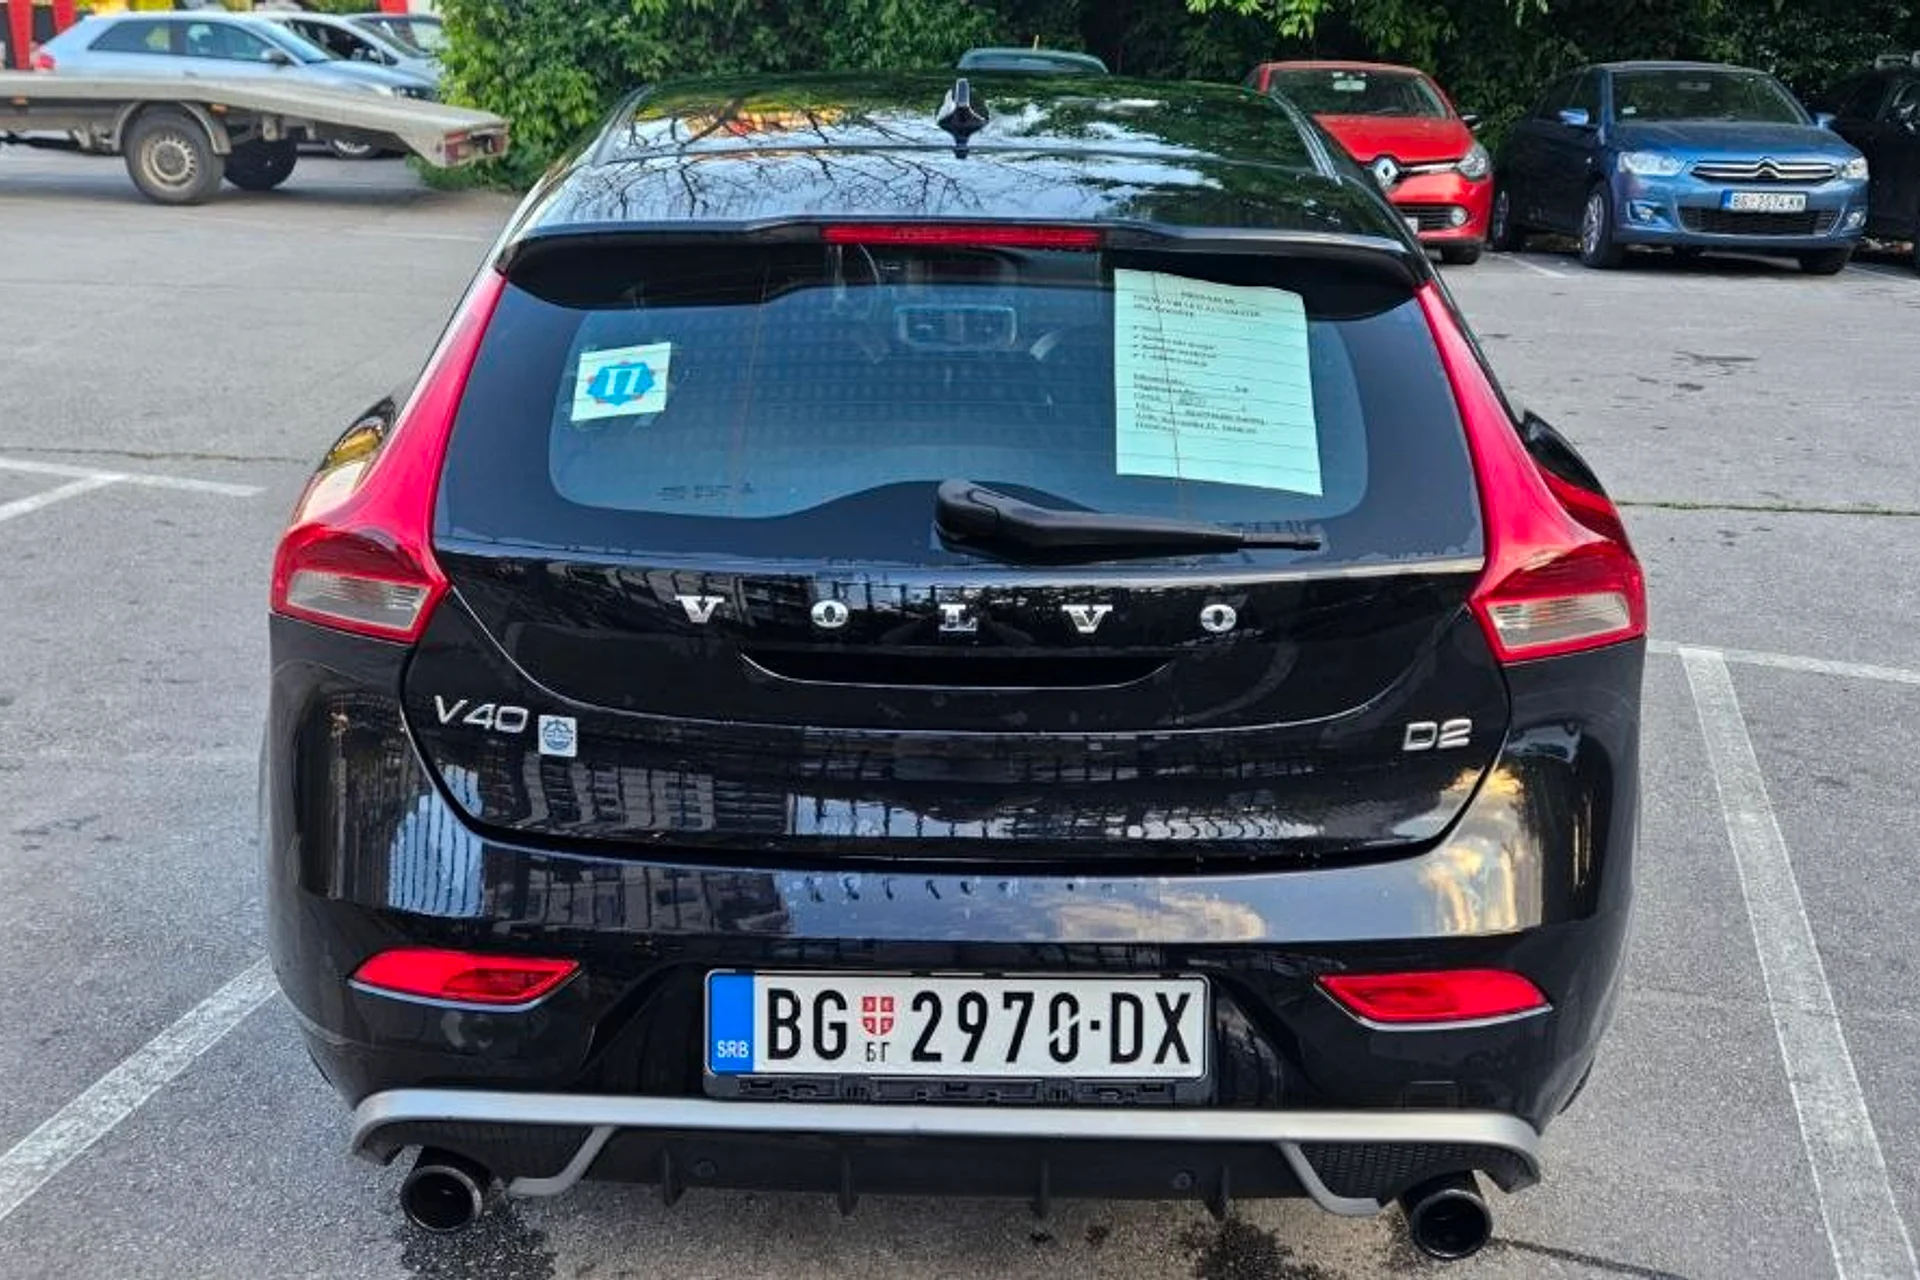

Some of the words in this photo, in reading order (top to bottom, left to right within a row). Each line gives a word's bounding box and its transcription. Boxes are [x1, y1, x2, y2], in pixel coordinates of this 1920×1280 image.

[675, 595, 1237, 634] VOLVO
[434, 695, 529, 733] V40
[1402, 719, 1472, 751] D2
[767, 988, 847, 1061] BG
[717, 1039, 749, 1058] SRB
